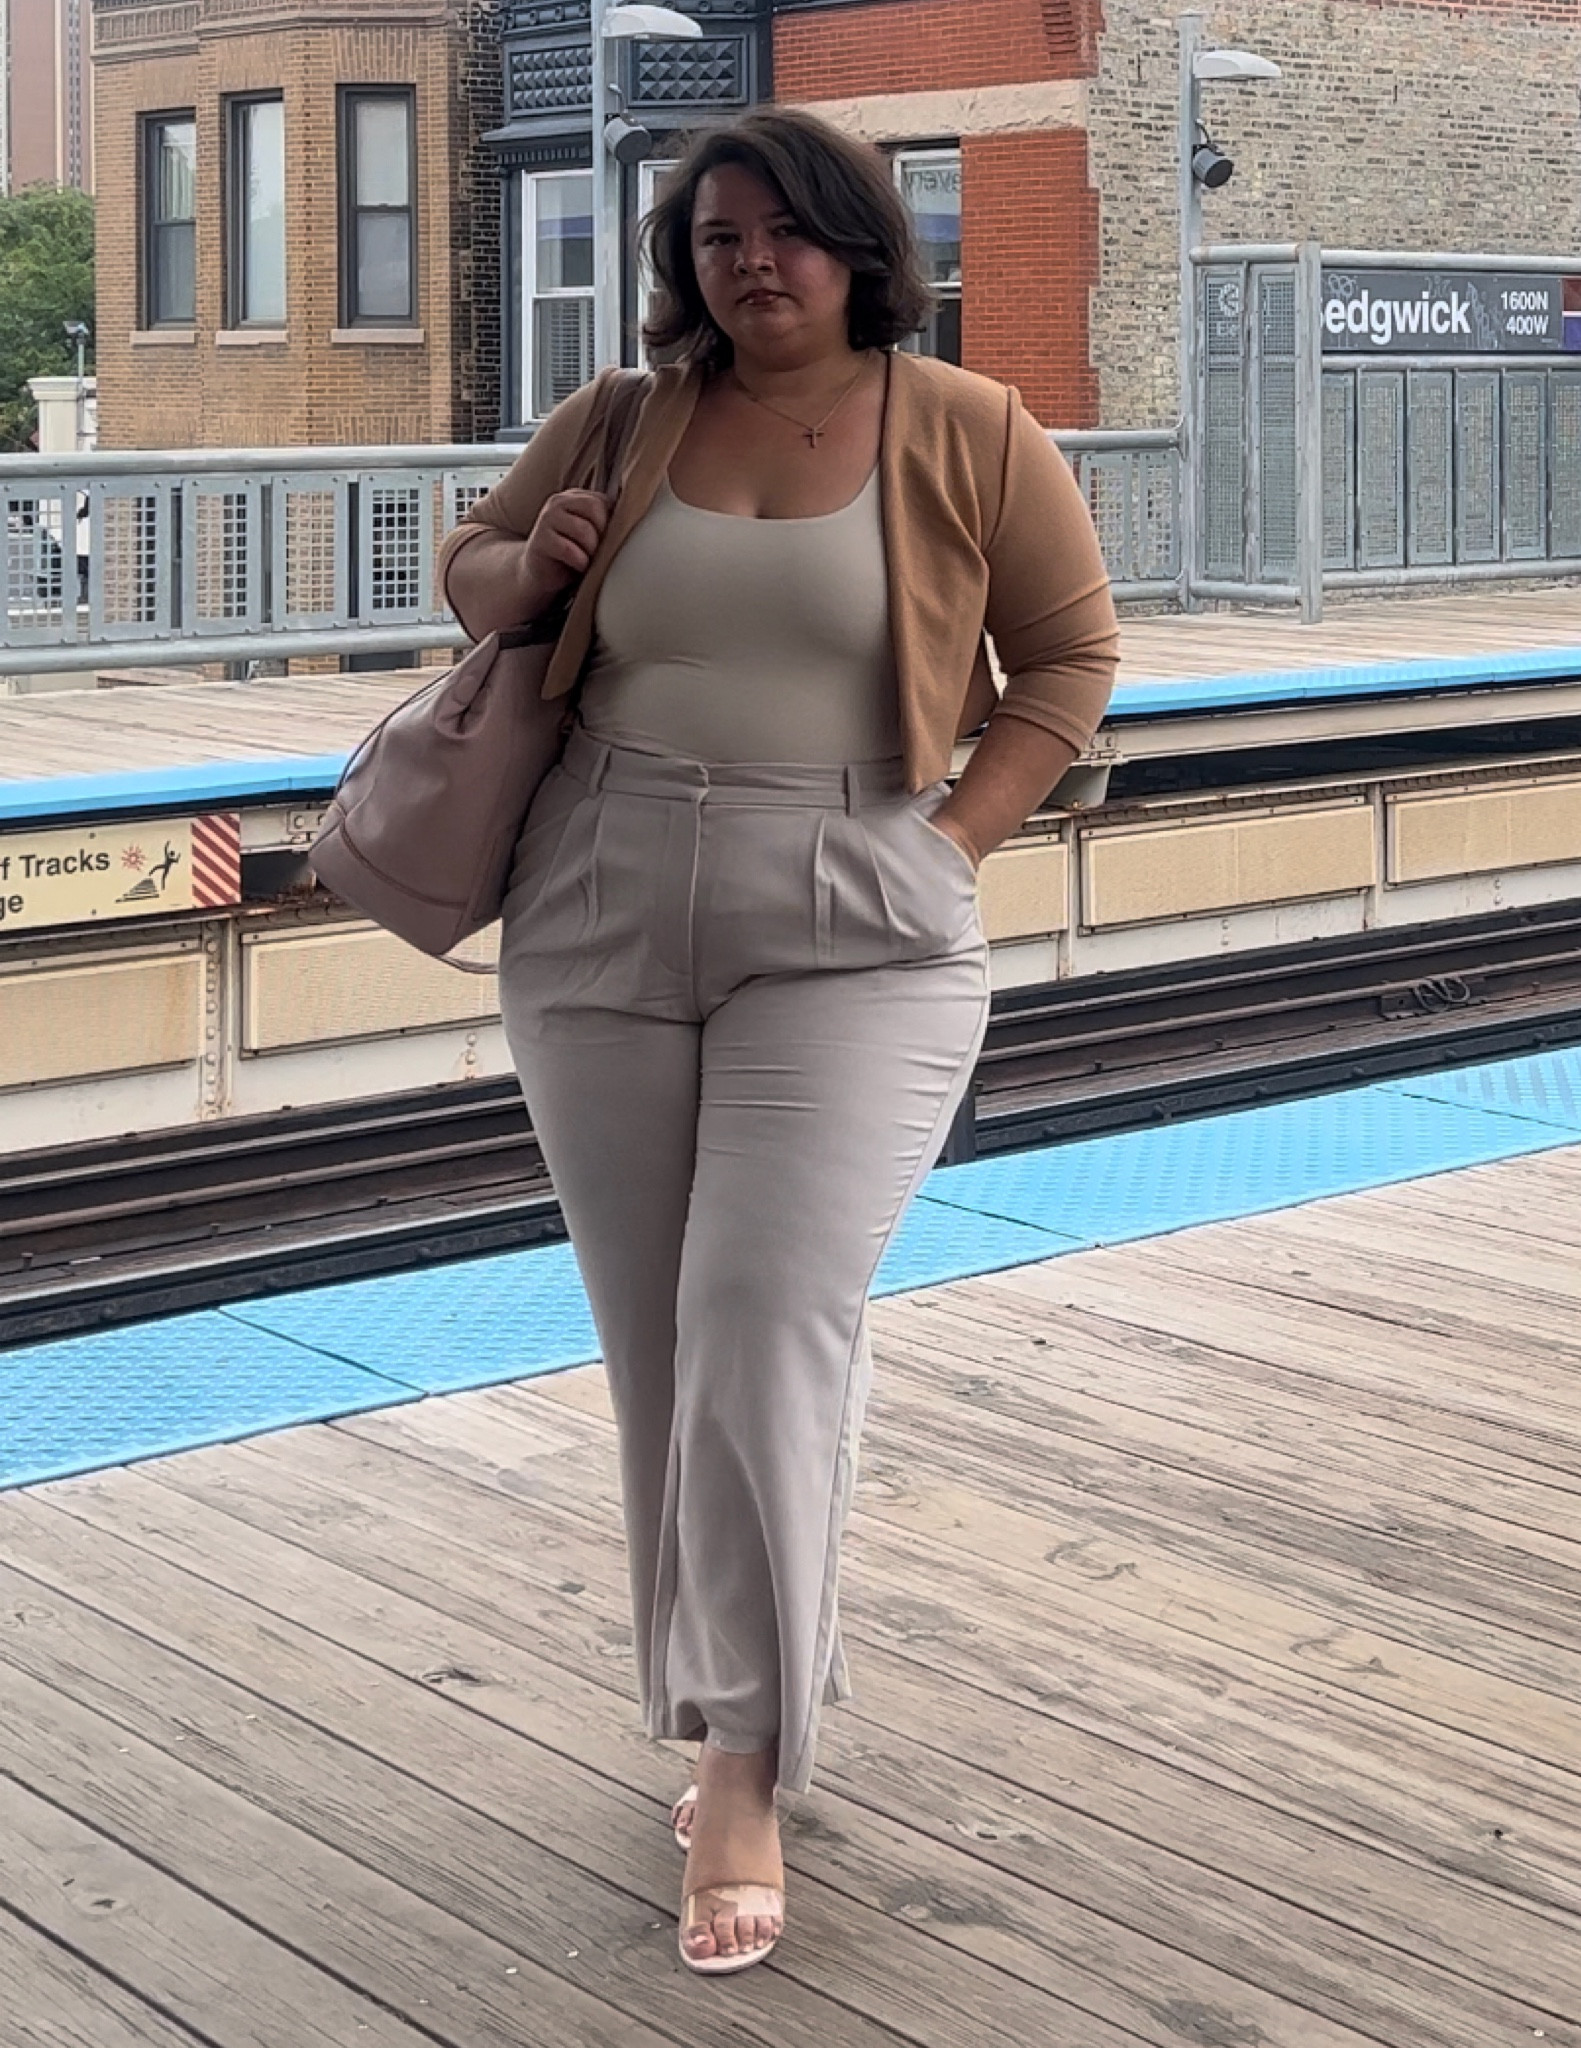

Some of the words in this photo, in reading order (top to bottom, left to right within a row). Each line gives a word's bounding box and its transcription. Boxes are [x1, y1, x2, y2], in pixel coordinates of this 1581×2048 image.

[1501, 290, 1549, 310] 1600N
[1320, 289, 1471, 345] edgwick
[1506, 315, 1549, 335] 400W
[18, 848, 110, 879] Tracks
